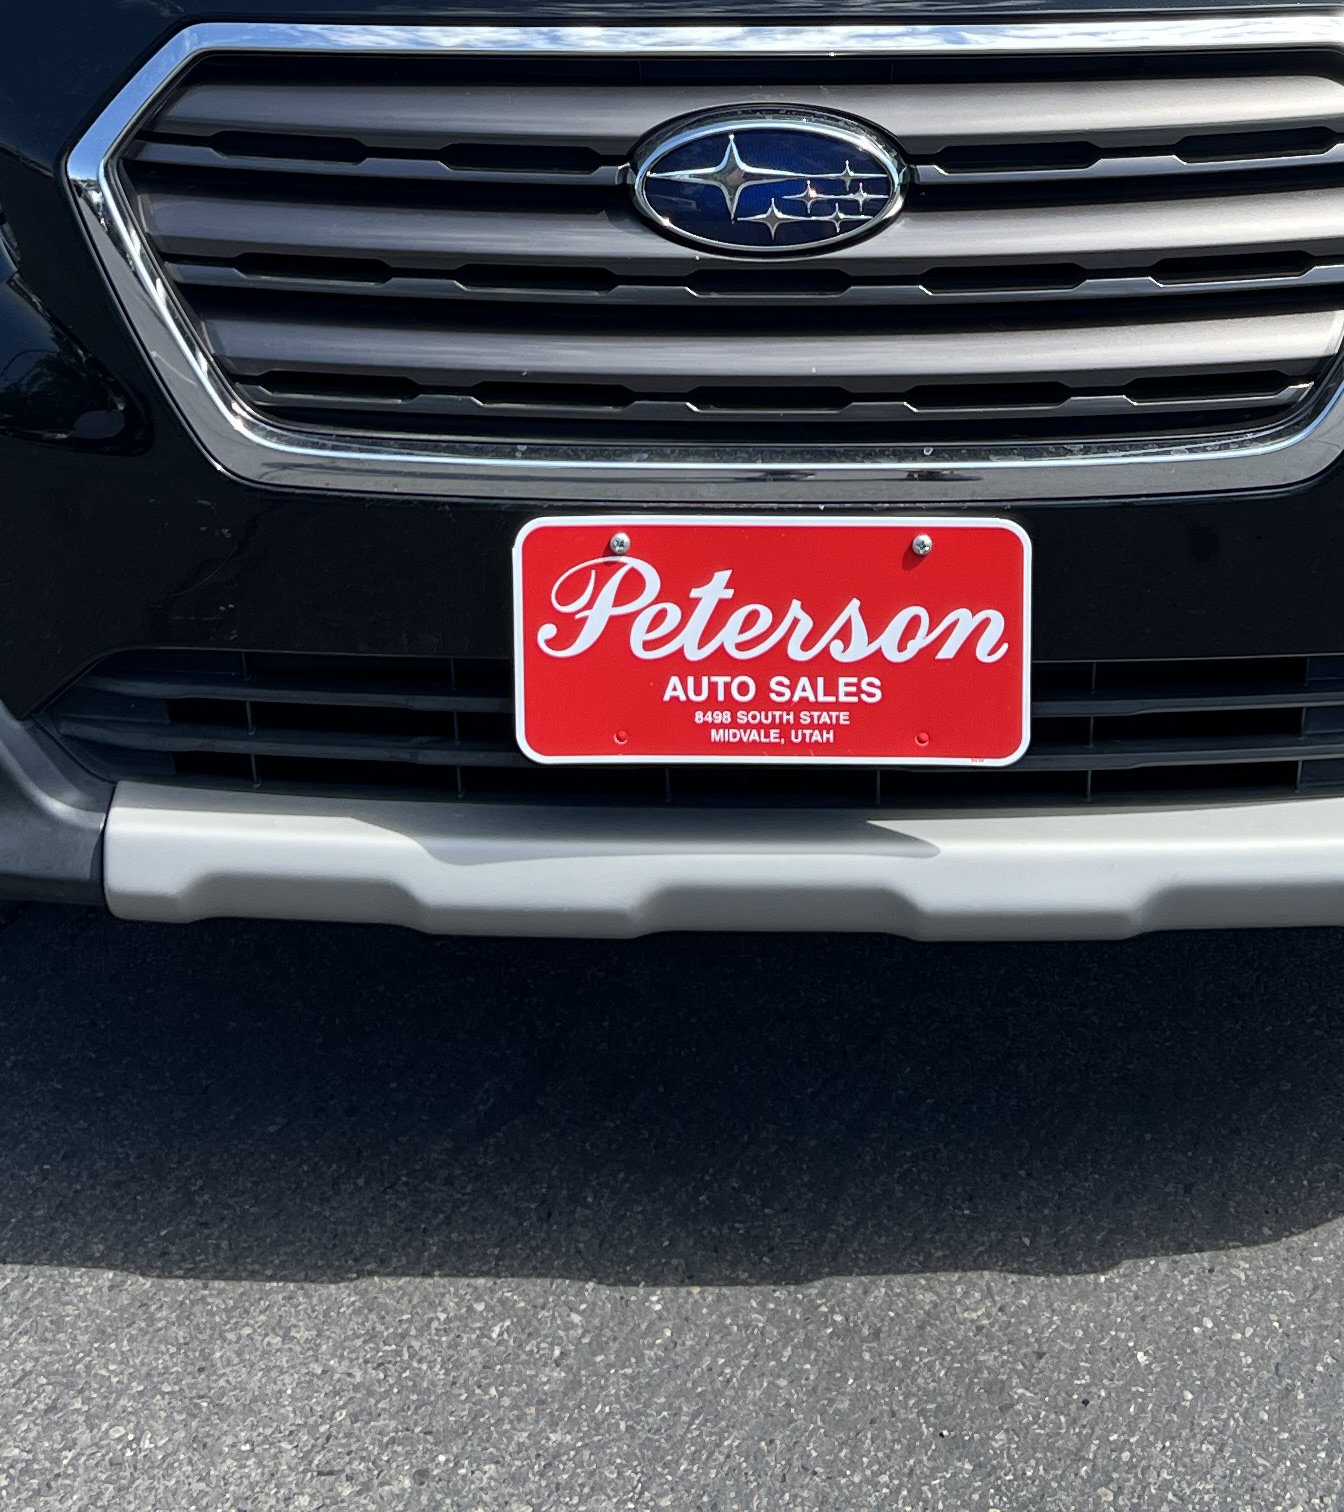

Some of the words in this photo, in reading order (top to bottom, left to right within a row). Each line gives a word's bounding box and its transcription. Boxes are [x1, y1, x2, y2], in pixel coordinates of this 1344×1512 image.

[536, 555, 1009, 663] Peterson
[663, 675, 757, 703] AUTO
[768, 675, 883, 704] SALES
[693, 710, 732, 724] 8498
[736, 710, 795, 725] SOUTH
[799, 711, 851, 725] STATE
[710, 729, 786, 745] MIDVALE,
[791, 729, 835, 744] UTAH
